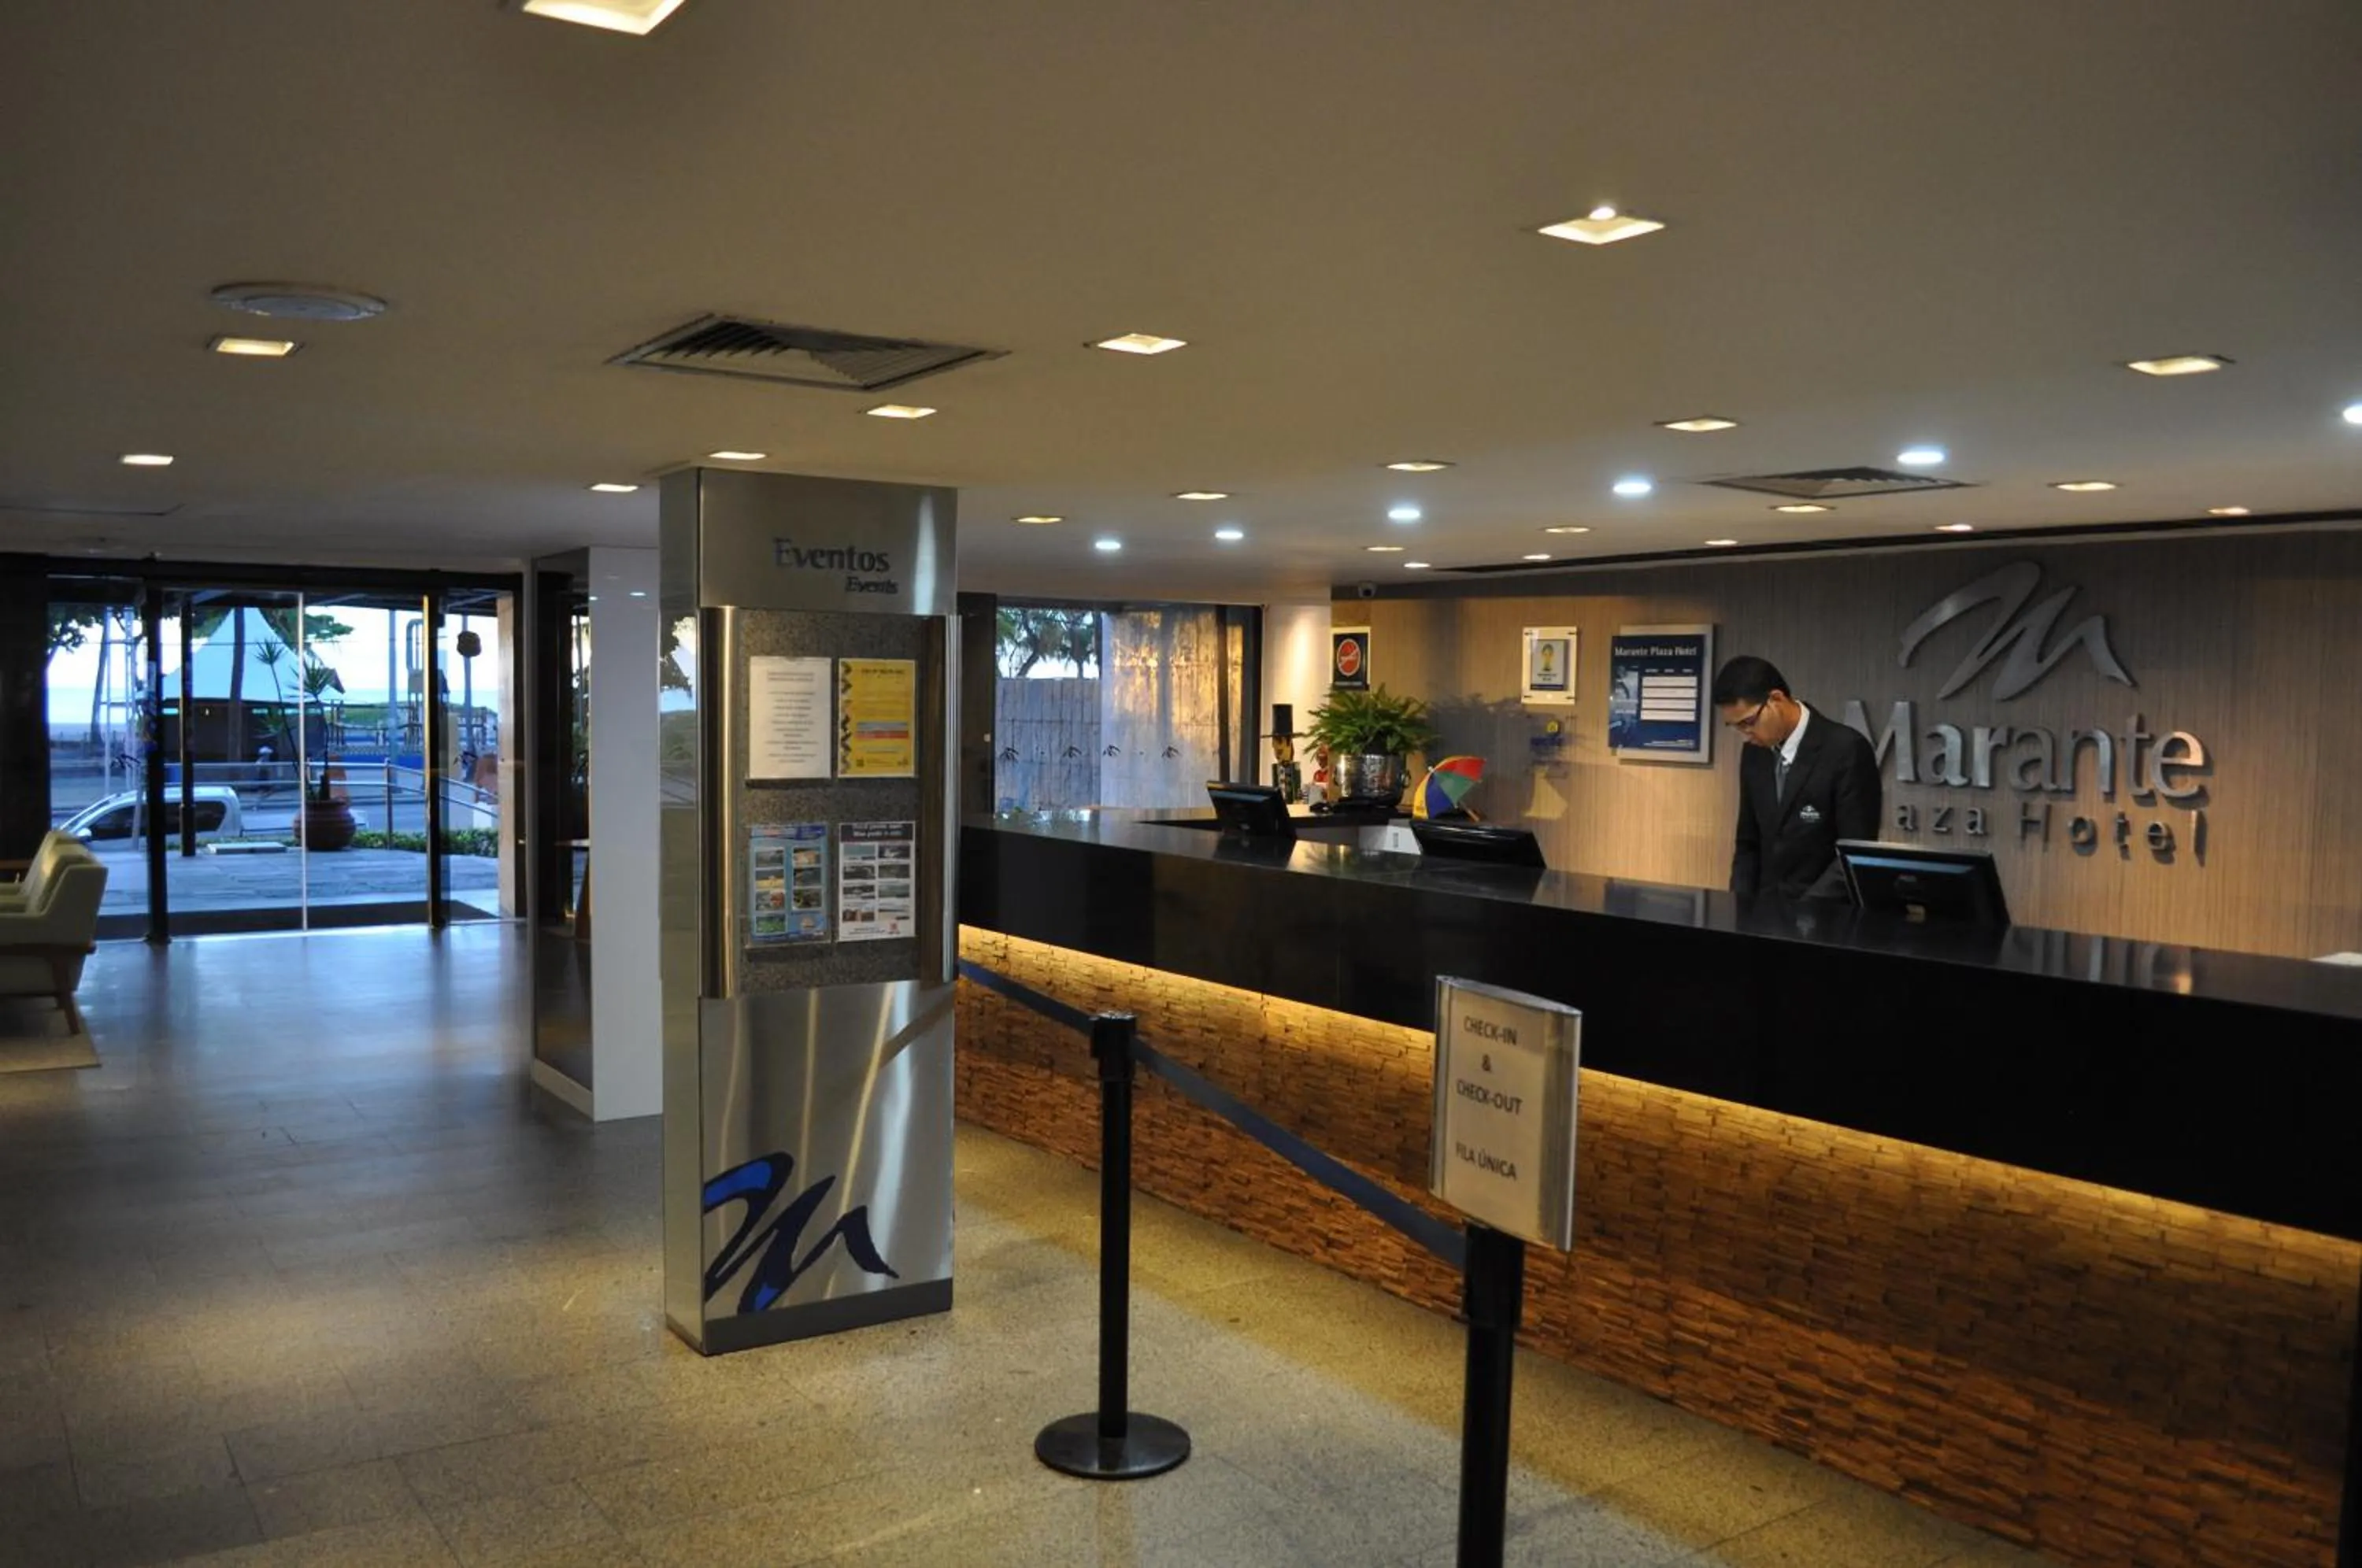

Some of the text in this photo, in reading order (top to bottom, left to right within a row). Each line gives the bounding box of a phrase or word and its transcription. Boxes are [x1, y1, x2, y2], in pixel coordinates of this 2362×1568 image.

[774, 538, 890, 572] Eventos
[846, 576, 898, 594] Events
[1843, 700, 2205, 798] Marante
[1896, 802, 2208, 854] aza Hotel
[1464, 1015, 1517, 1046] CHECK-IN
[1482, 1054, 1491, 1072] &
[1457, 1079, 1522, 1115] CHECK-OUT
[1456, 1141, 1475, 1165] FILA
